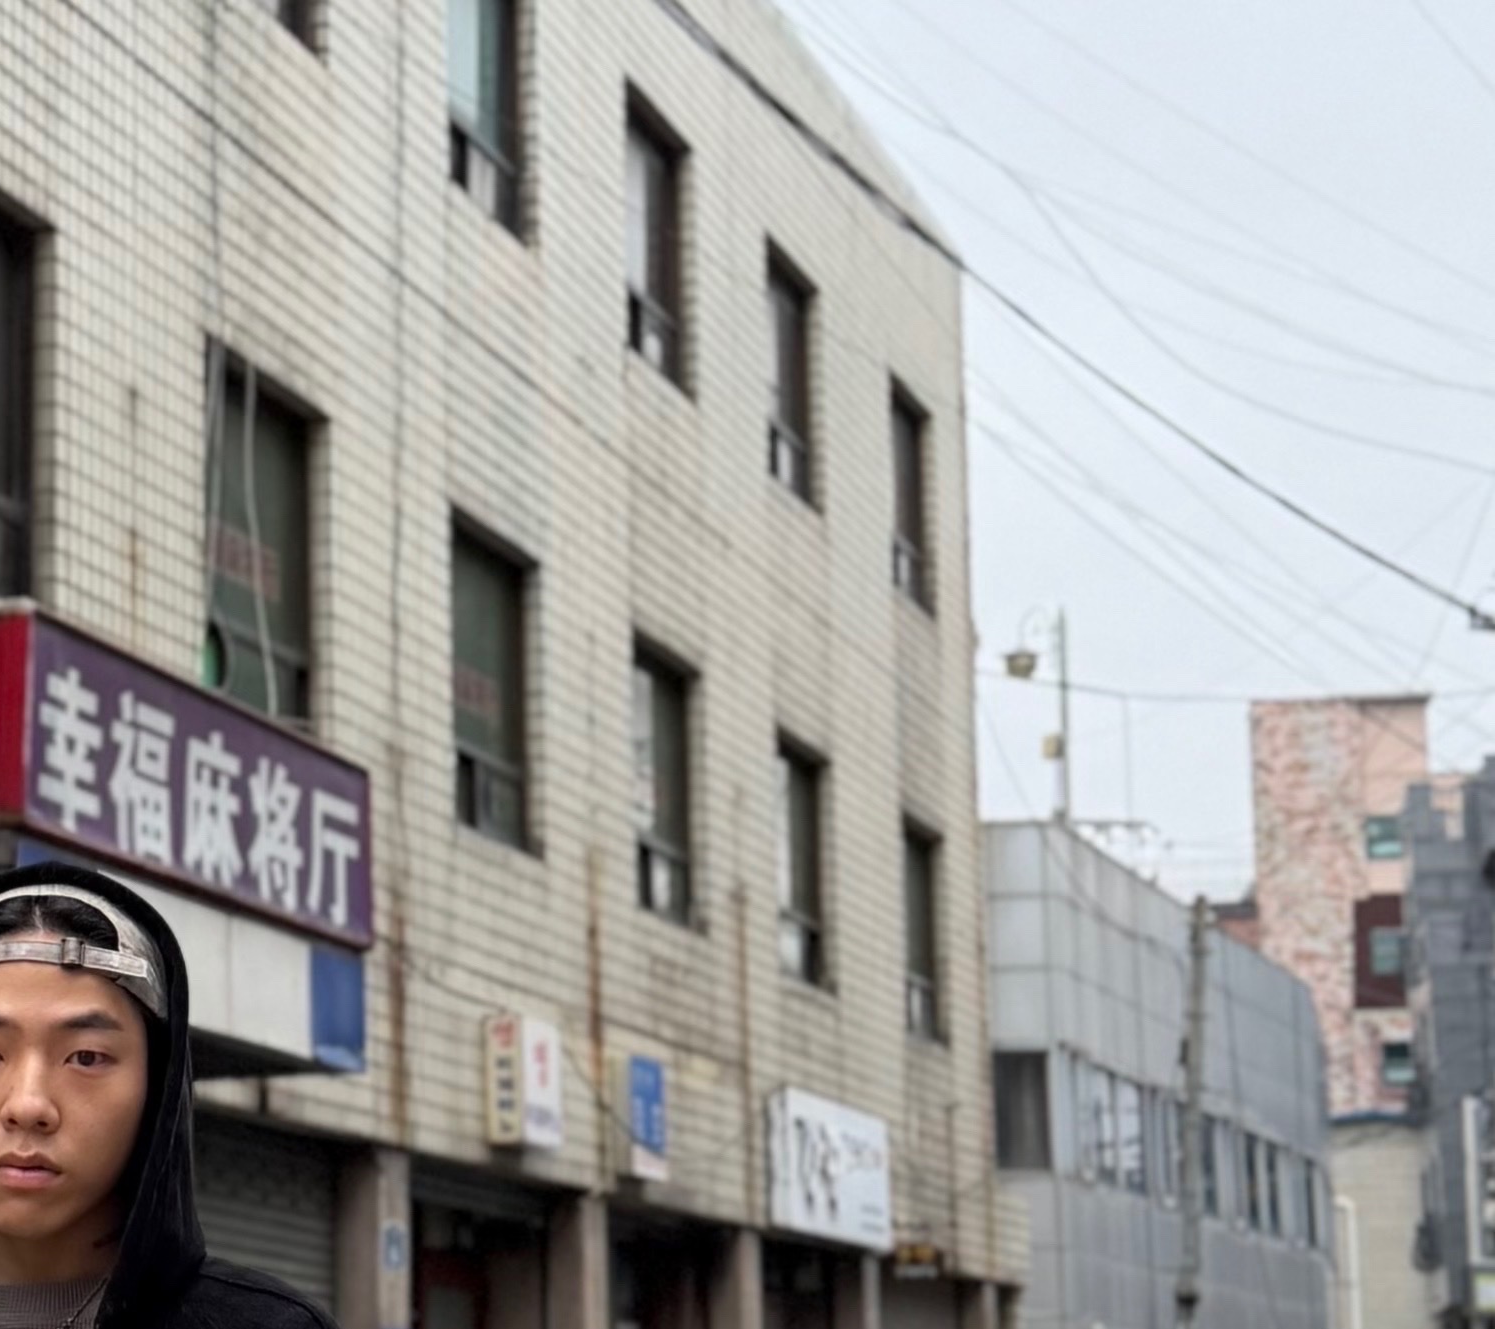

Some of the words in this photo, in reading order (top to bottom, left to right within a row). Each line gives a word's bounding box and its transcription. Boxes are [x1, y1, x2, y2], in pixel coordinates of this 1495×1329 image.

[38, 667, 359, 927] 幸福麻将厅
